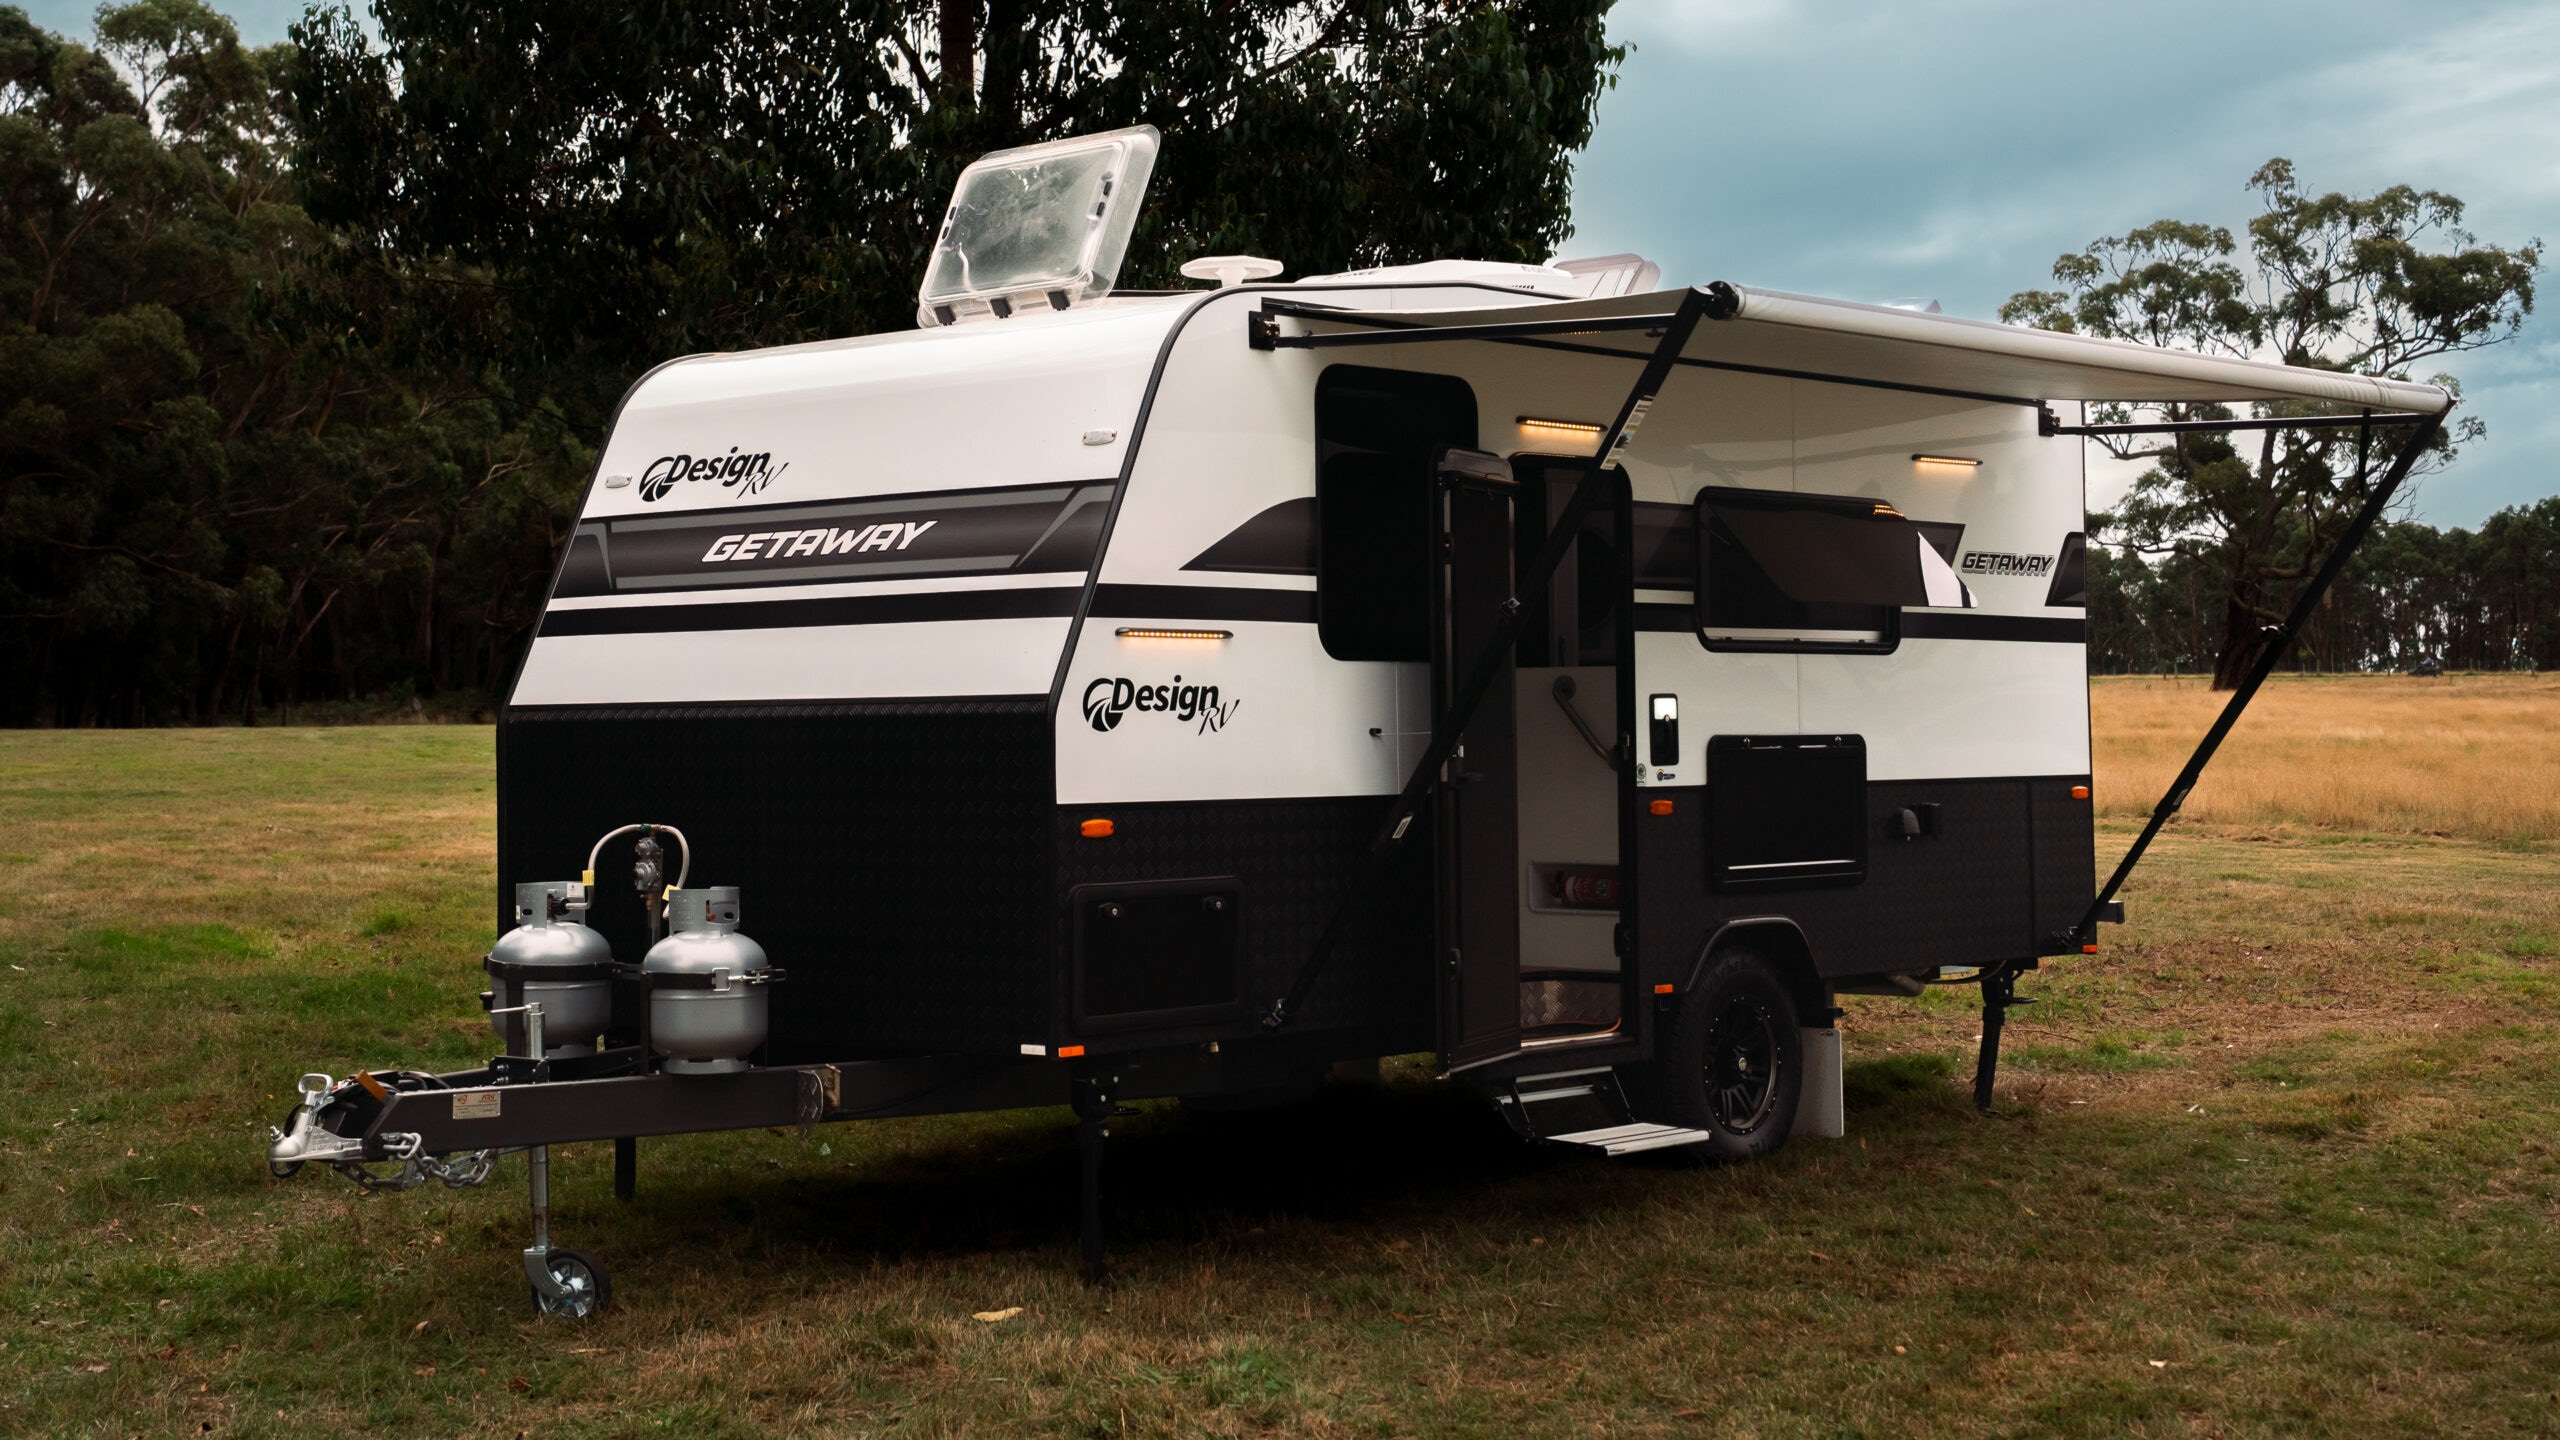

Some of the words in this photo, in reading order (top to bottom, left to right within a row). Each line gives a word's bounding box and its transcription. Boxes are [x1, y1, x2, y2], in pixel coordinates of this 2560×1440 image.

[666, 446, 771, 487] Design
[737, 462, 790, 499] RV
[702, 520, 938, 562] GETAWAY
[1962, 552, 2054, 574] GETAWAY
[1111, 675, 1218, 721] Design
[1198, 699, 1240, 736] RV
